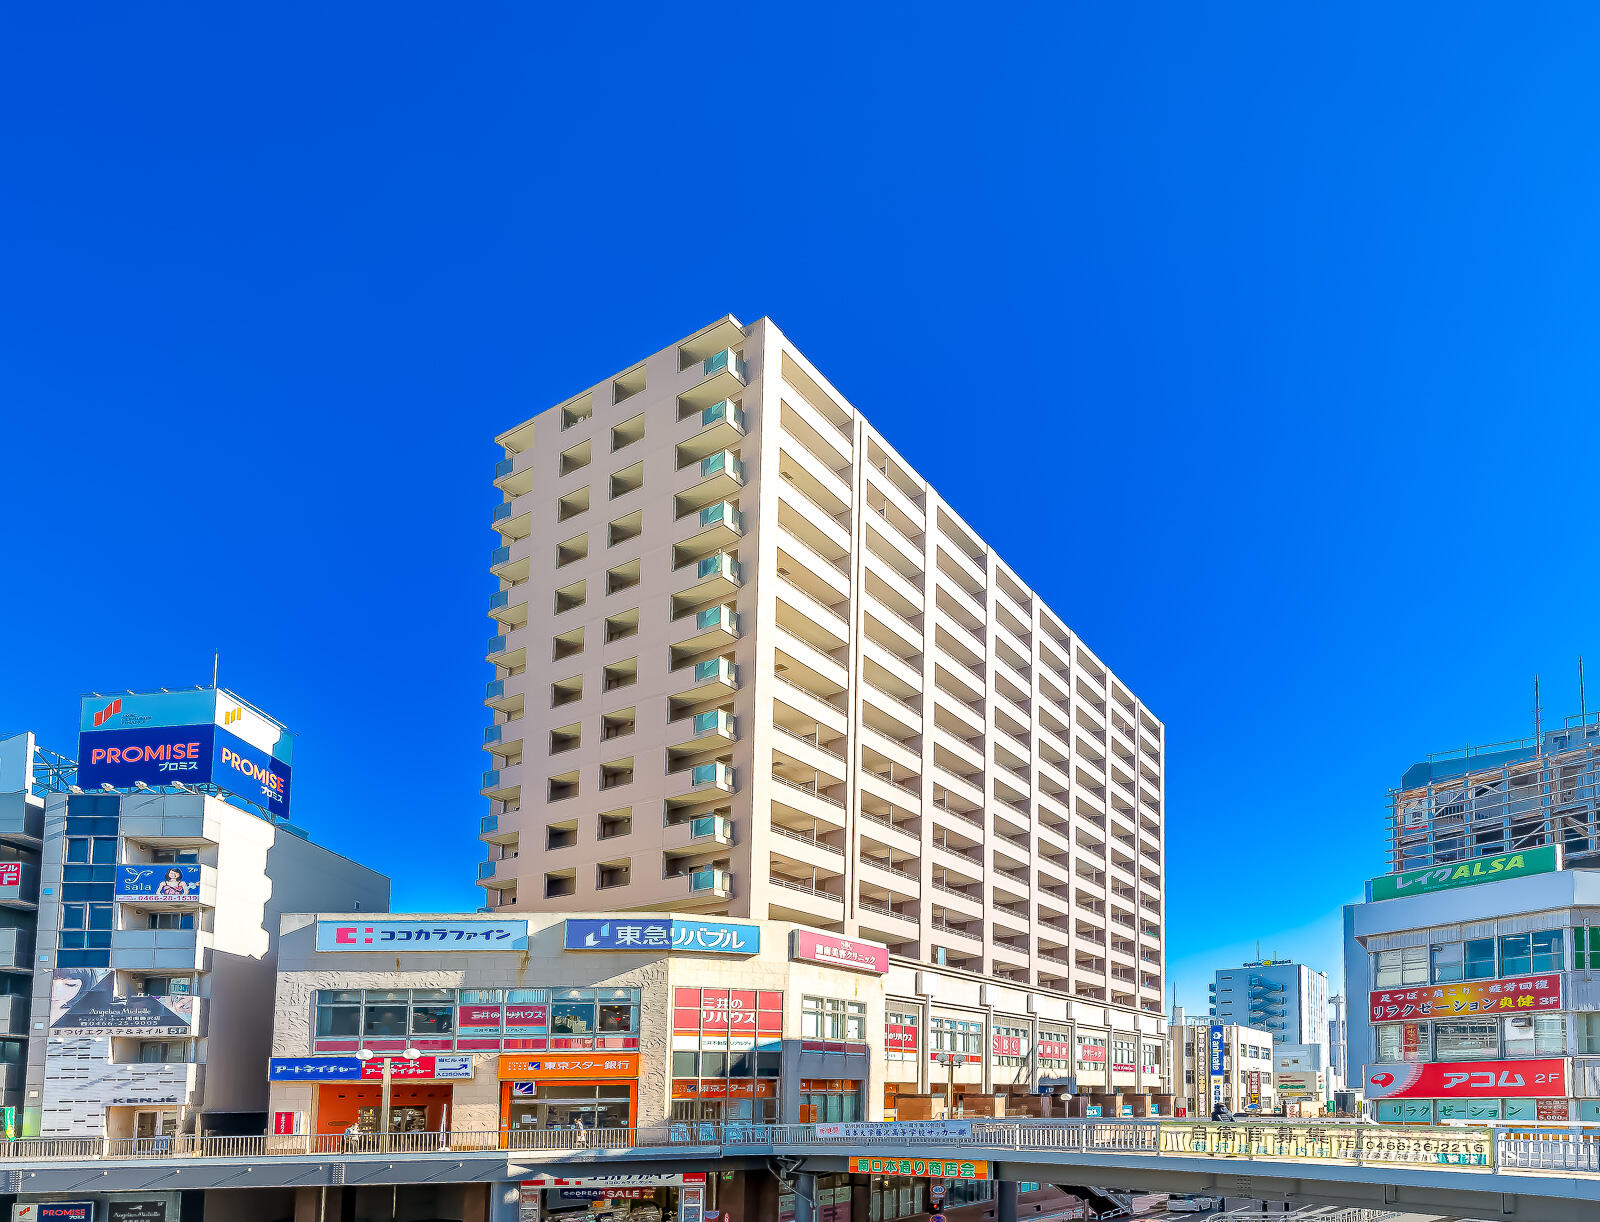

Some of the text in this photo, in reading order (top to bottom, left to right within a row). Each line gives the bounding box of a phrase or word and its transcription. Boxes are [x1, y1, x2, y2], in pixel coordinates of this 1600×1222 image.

[92, 743, 200, 764] PROMISE
[158, 762, 199, 771] プロミス
[222, 747, 284, 793] PROMISE
[261, 786, 283, 803] プロミス
[380, 928, 511, 941] ココカラファイン
[616, 925, 746, 949] 東急リバブル
[703, 997, 743, 1009] 三井の
[1539, 996, 1559, 1005] 3F
[703, 1011, 755, 1024] リハウス
[274, 1065, 358, 1073] アートネイチャー
[544, 1060, 630, 1070] 東京スター銀行
[1443, 1070, 1559, 1088] アコム 2F
[858, 1158, 976, 1178] 南口本通り商店会
[606, 1190, 640, 1198] SALE
[42, 1208, 86, 1216] PROMISE
